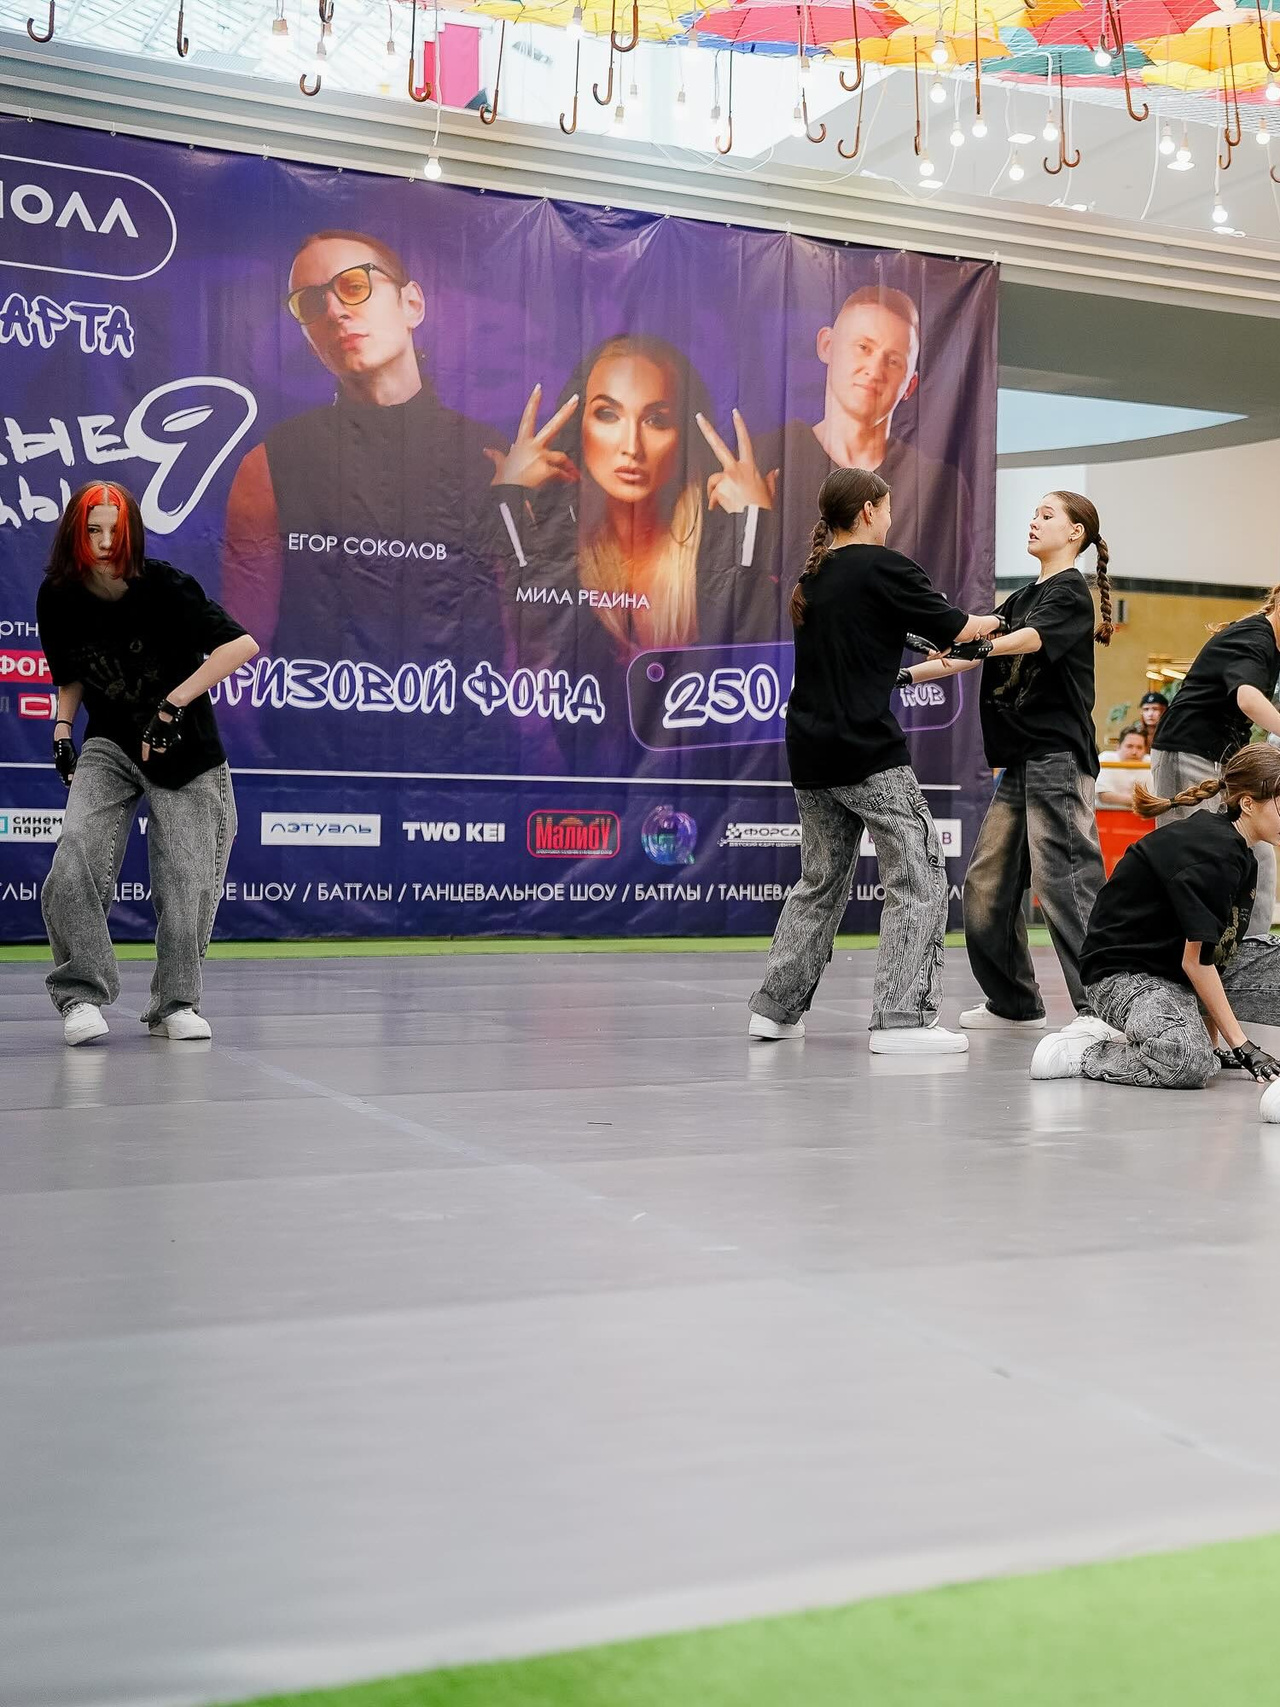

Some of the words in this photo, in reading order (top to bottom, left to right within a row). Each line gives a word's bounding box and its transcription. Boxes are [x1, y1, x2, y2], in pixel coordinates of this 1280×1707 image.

[0, 180, 138, 238] ОЛЛ
[0, 293, 134, 358] АРТА
[288, 533, 338, 553] ЕГОР
[344, 536, 447, 561] СОКОЛОВ
[515, 586, 573, 605] МИЛА
[578, 590, 651, 610] РЕДИНА
[0, 655, 50, 677] ФОР
[13, 816, 63, 826] синем
[402, 821, 460, 842] TWO
[13, 826, 52, 838] парк
[744, 828, 801, 837] ФОРСА
[0, 883, 37, 901] ЛЫ
[243, 883, 296, 901] ШОУ
[318, 883, 393, 901] БАТТЛЫ
[412, 883, 564, 902] ТАНЦЕВАЛЬНОЕ
[570, 884, 617, 901] ШОУ
[635, 884, 701, 901] БАТТЛЫ
